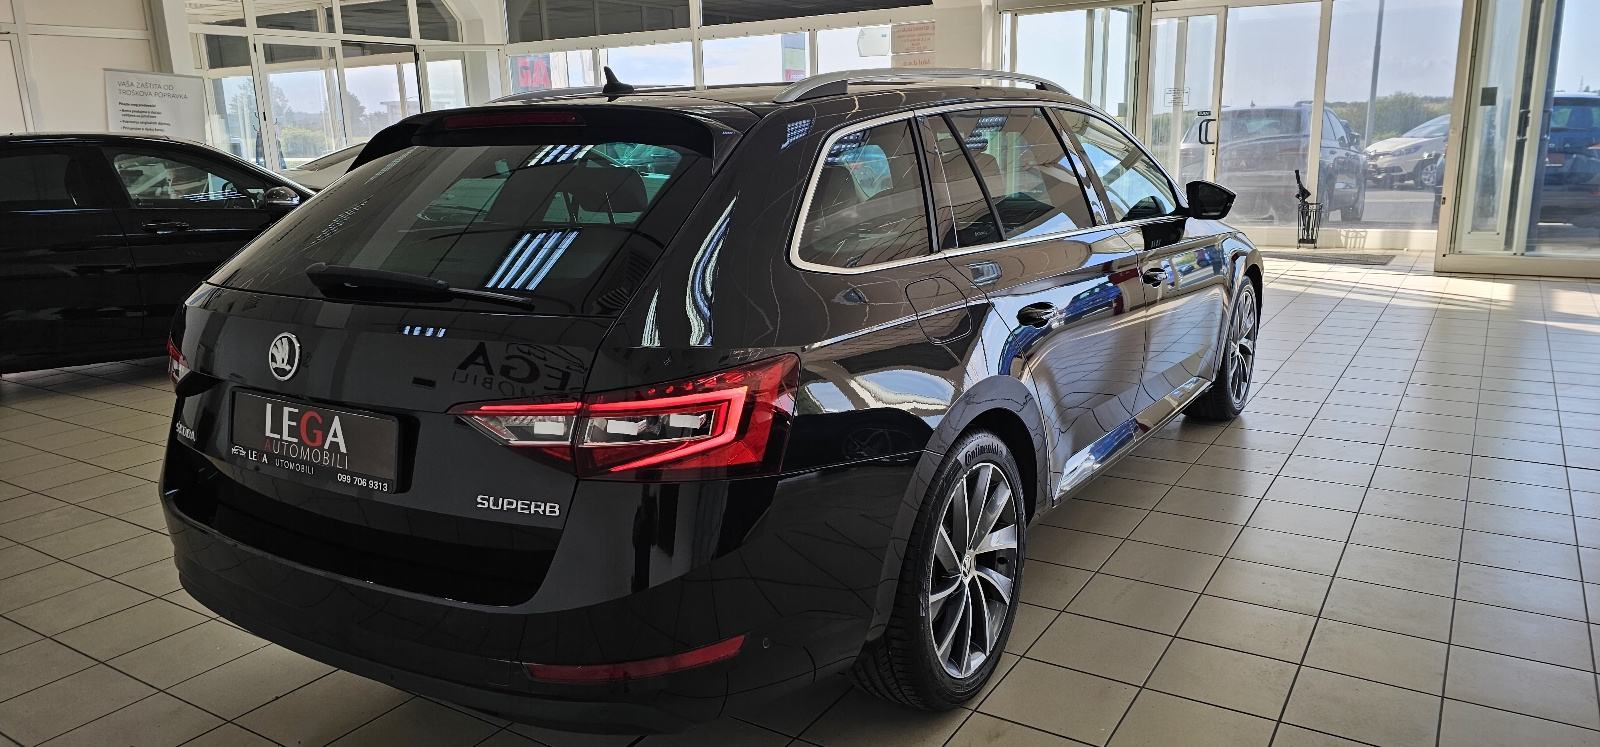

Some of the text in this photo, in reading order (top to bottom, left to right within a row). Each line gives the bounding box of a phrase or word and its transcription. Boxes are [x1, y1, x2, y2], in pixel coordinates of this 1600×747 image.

[154, 91, 188, 99] POPRAVKA
[265, 402, 347, 453] LEGA
[264, 438, 348, 470] AUTOMOBILI
[337, 473, 388, 491] 099 706 9313
[476, 494, 560, 516] SUPERB
